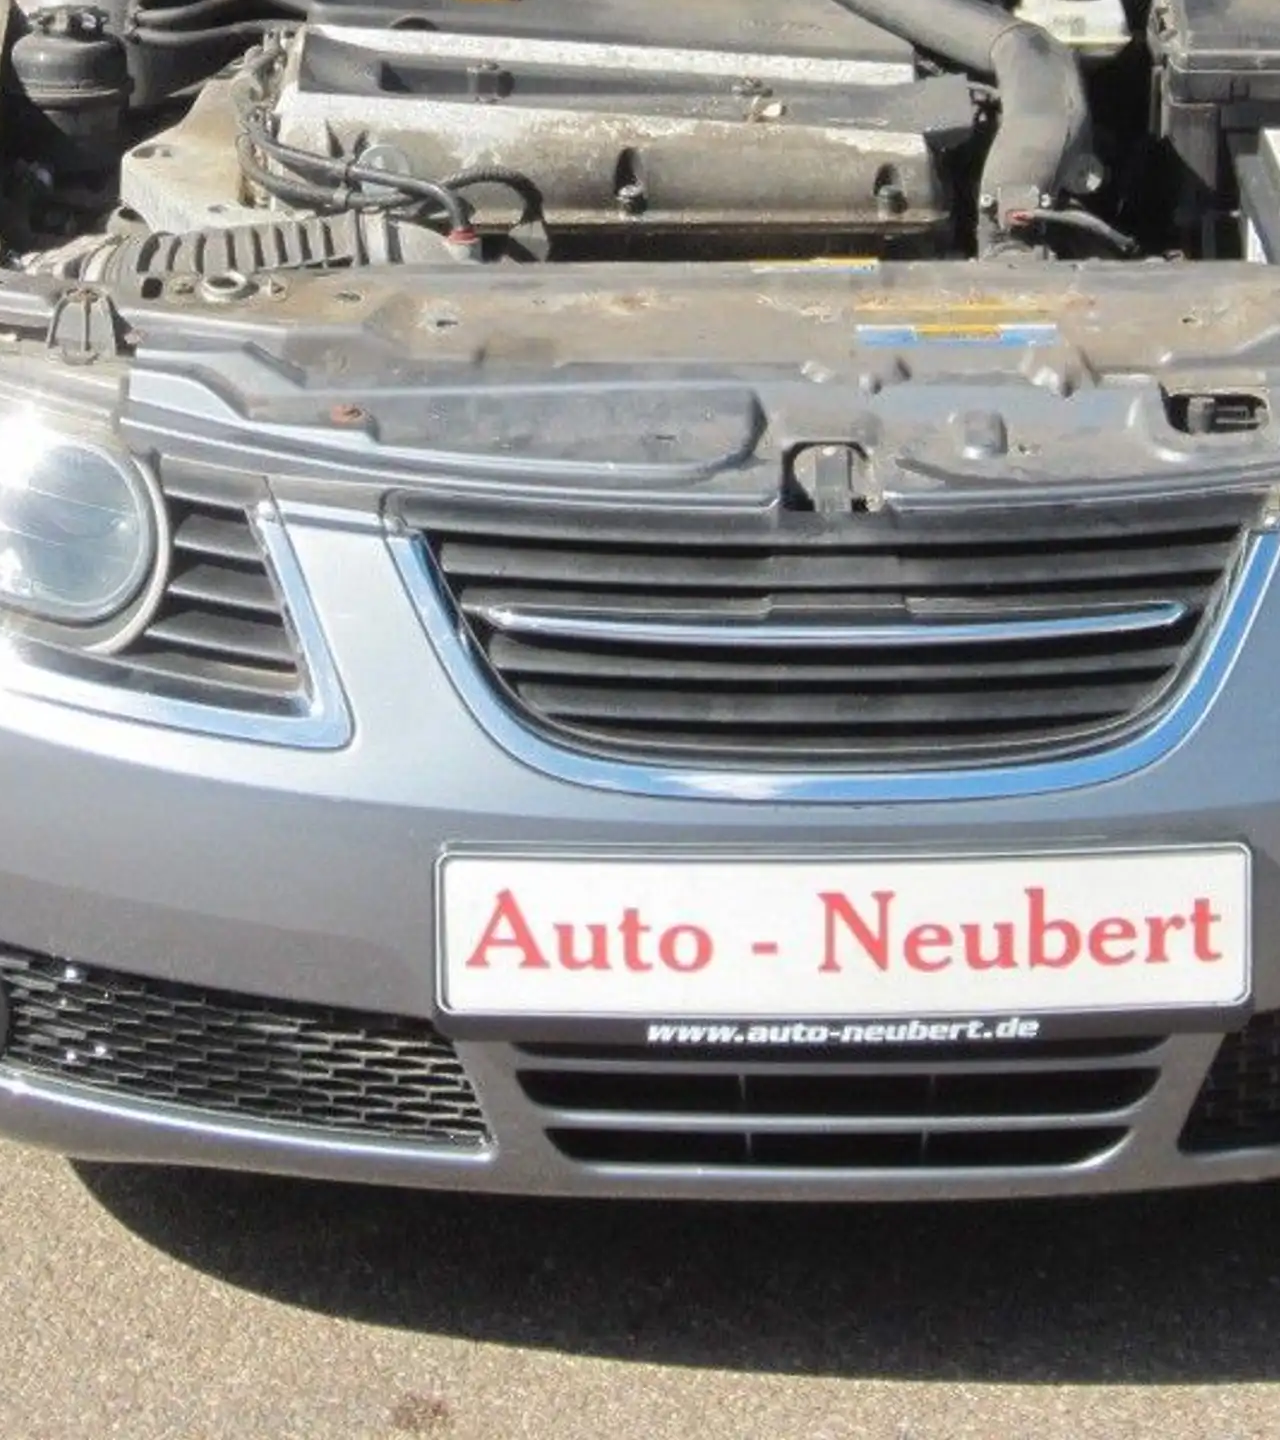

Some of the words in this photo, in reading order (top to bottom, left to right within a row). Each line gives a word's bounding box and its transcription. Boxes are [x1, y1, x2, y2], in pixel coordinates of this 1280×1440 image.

[466, 889, 713, 972] Auto
[751, 939, 779, 957] -
[817, 885, 1221, 973] Neubert
[645, 1016, 1041, 1044] www.auto-neubert.de
